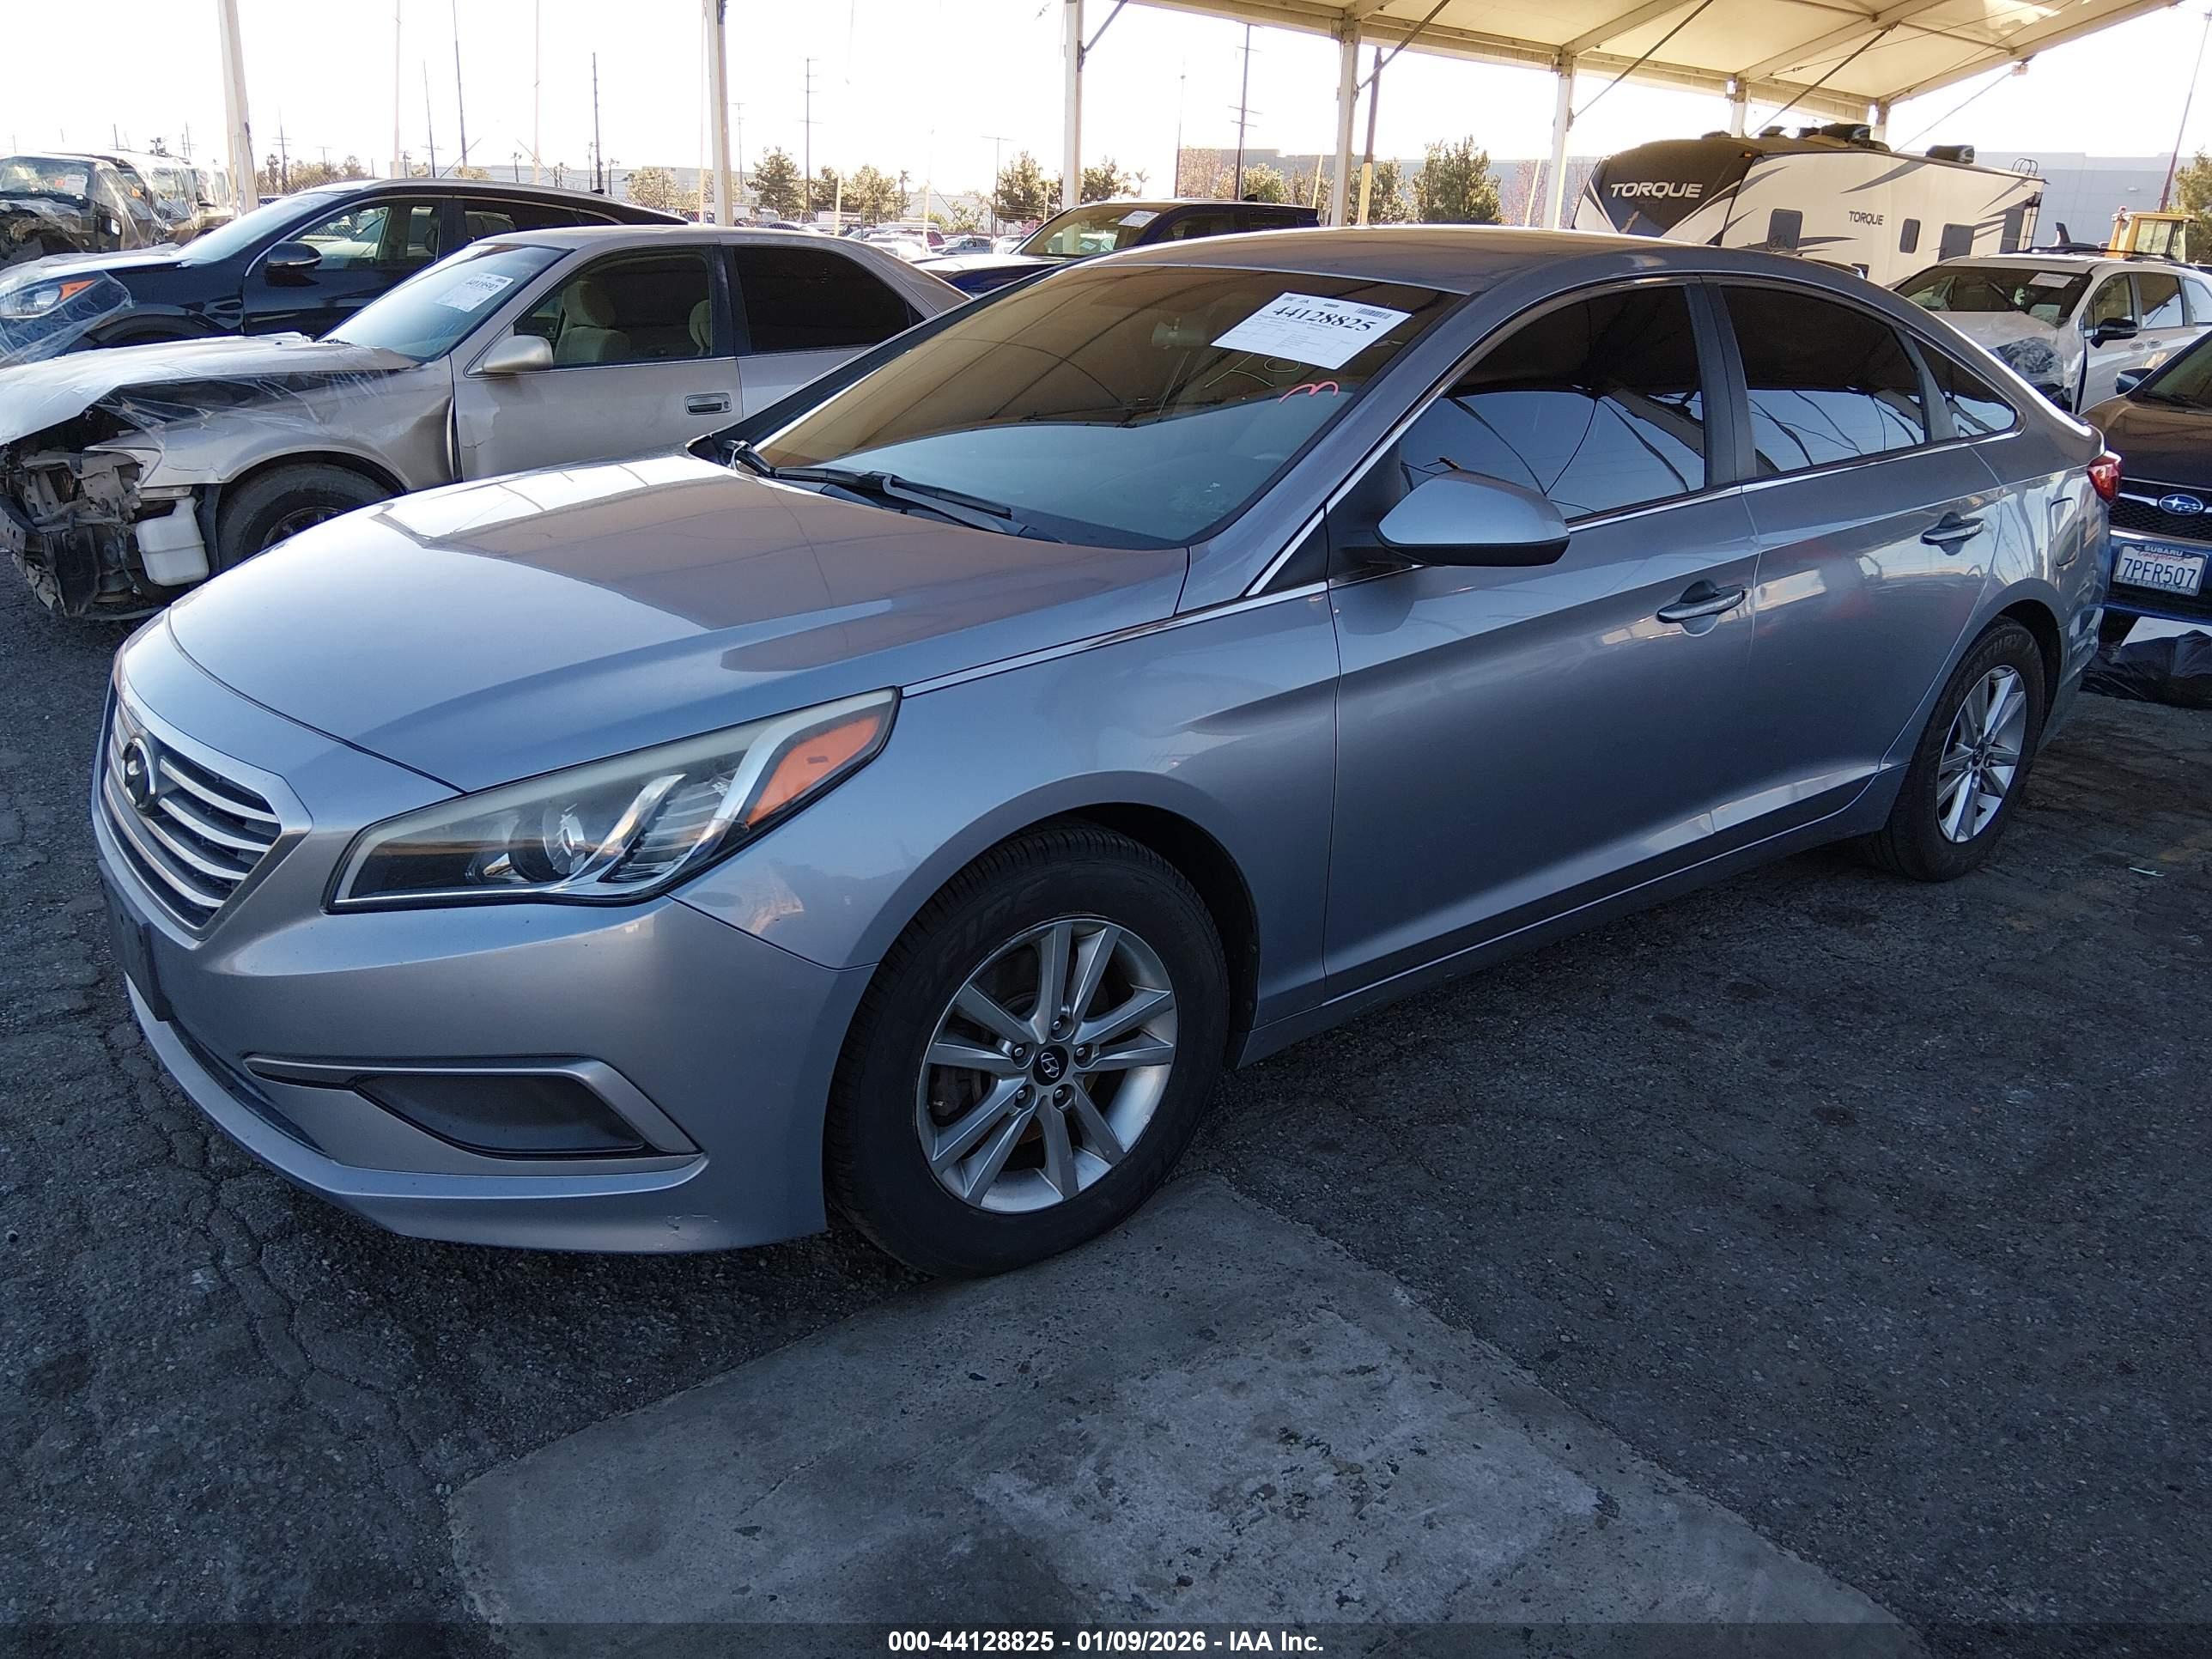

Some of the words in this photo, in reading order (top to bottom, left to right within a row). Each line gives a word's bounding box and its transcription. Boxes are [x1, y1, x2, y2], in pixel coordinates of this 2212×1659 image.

[1610, 182, 1704, 199] TORQUE
[1849, 210, 1885, 226] TORQUE
[1273, 306, 1378, 331] 44128825
[2144, 545, 2184, 556] SUBARU
[2123, 557, 2197, 587] 7PFR507
